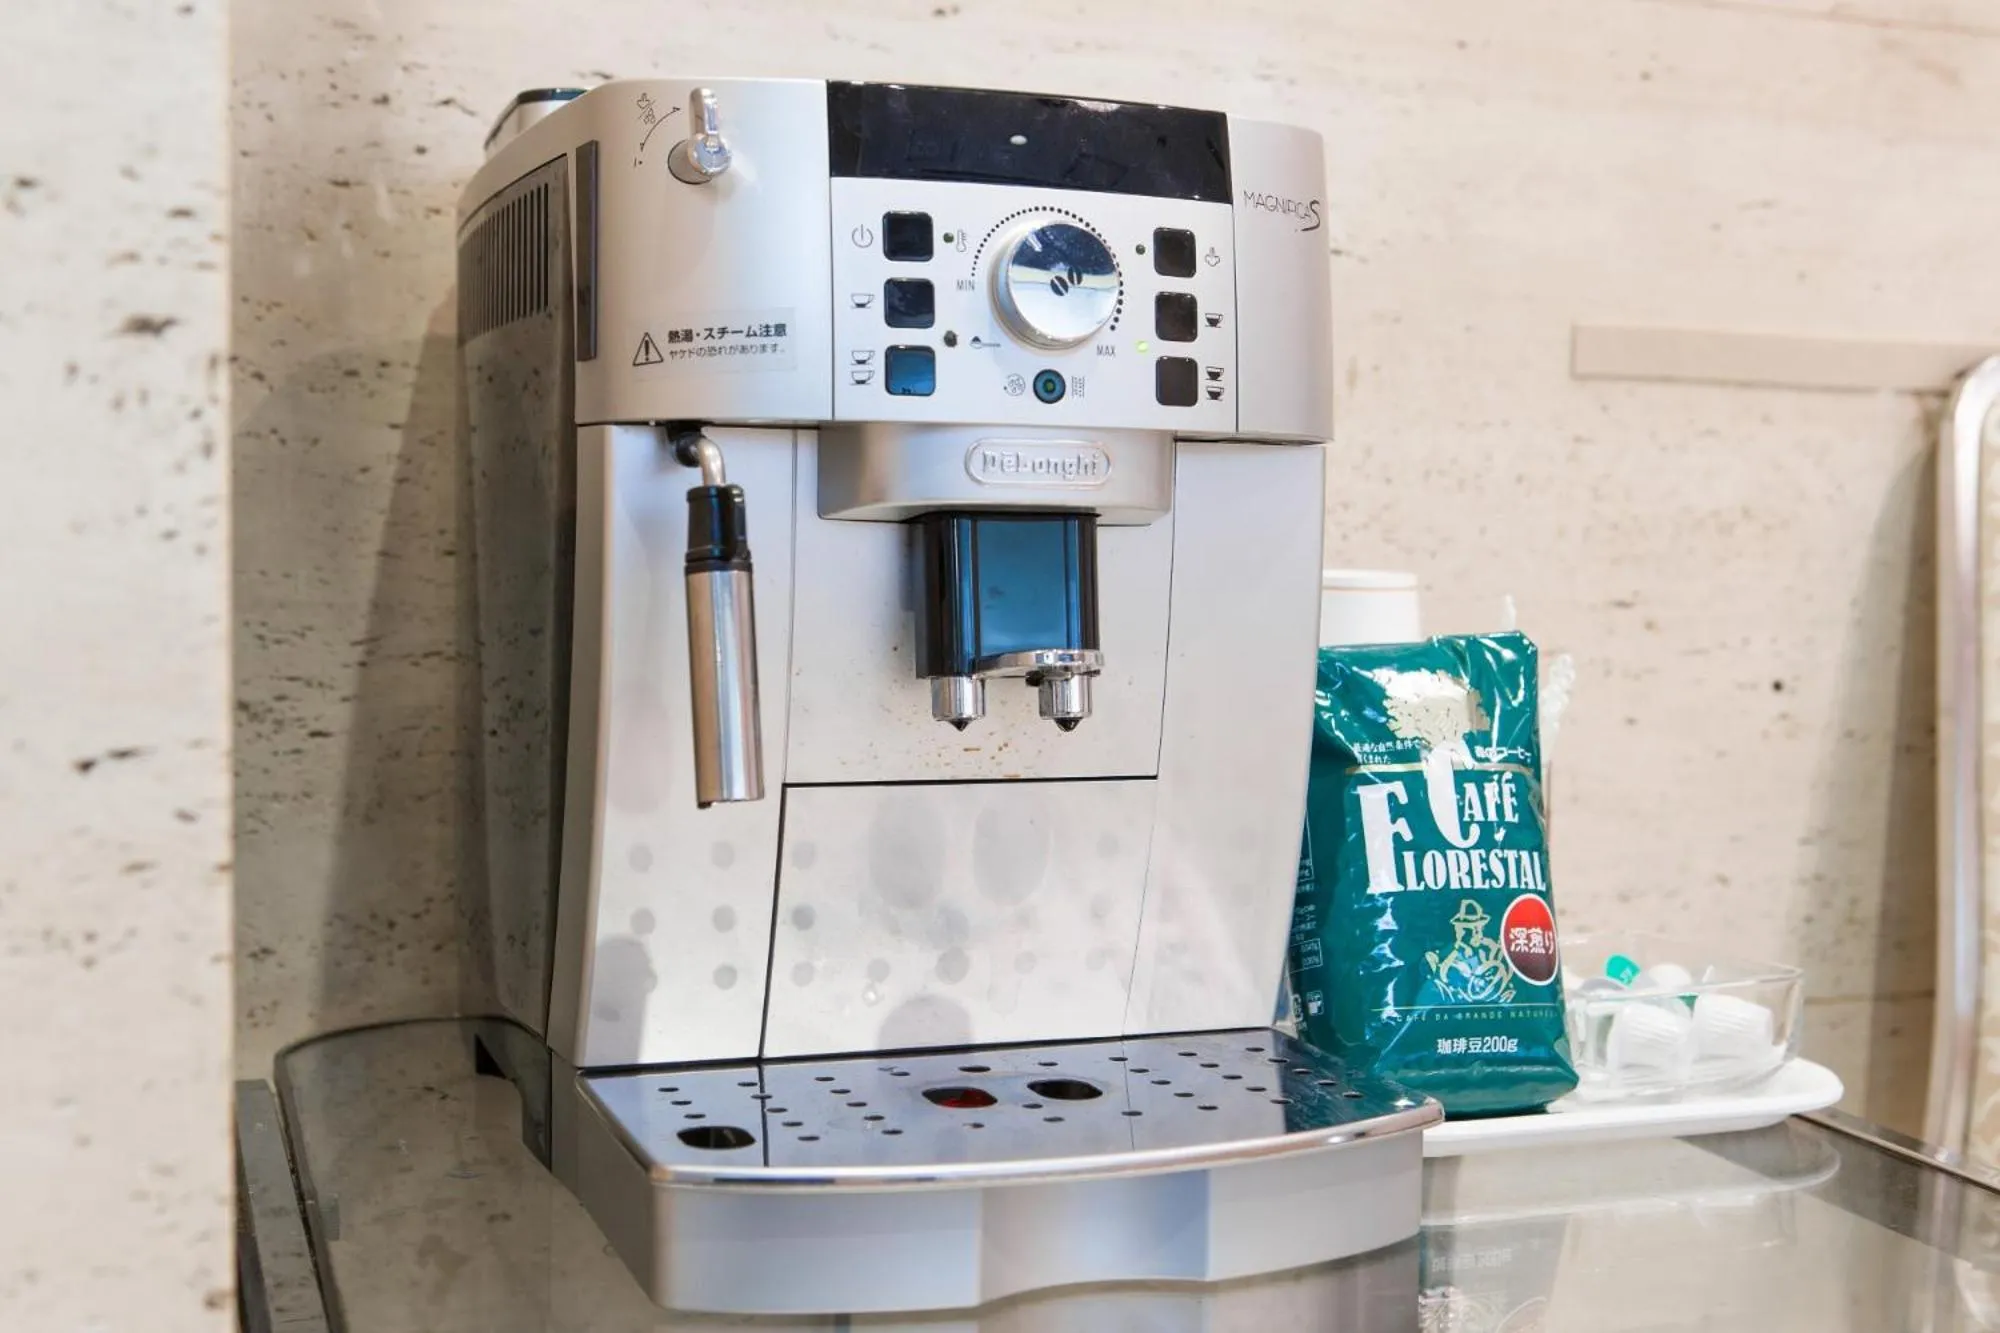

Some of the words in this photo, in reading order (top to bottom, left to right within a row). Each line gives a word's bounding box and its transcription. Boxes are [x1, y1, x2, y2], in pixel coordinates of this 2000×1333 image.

[956, 279, 975, 291] MIN
[667, 323, 787, 344] 熱湯・スチーム注意
[1096, 345, 1116, 357] MAX
[1356, 781, 1546, 895] FLORESTAL
[1508, 927, 1555, 955] 深煎り
[1436, 1035, 1518, 1055] 珈琲豆200g
